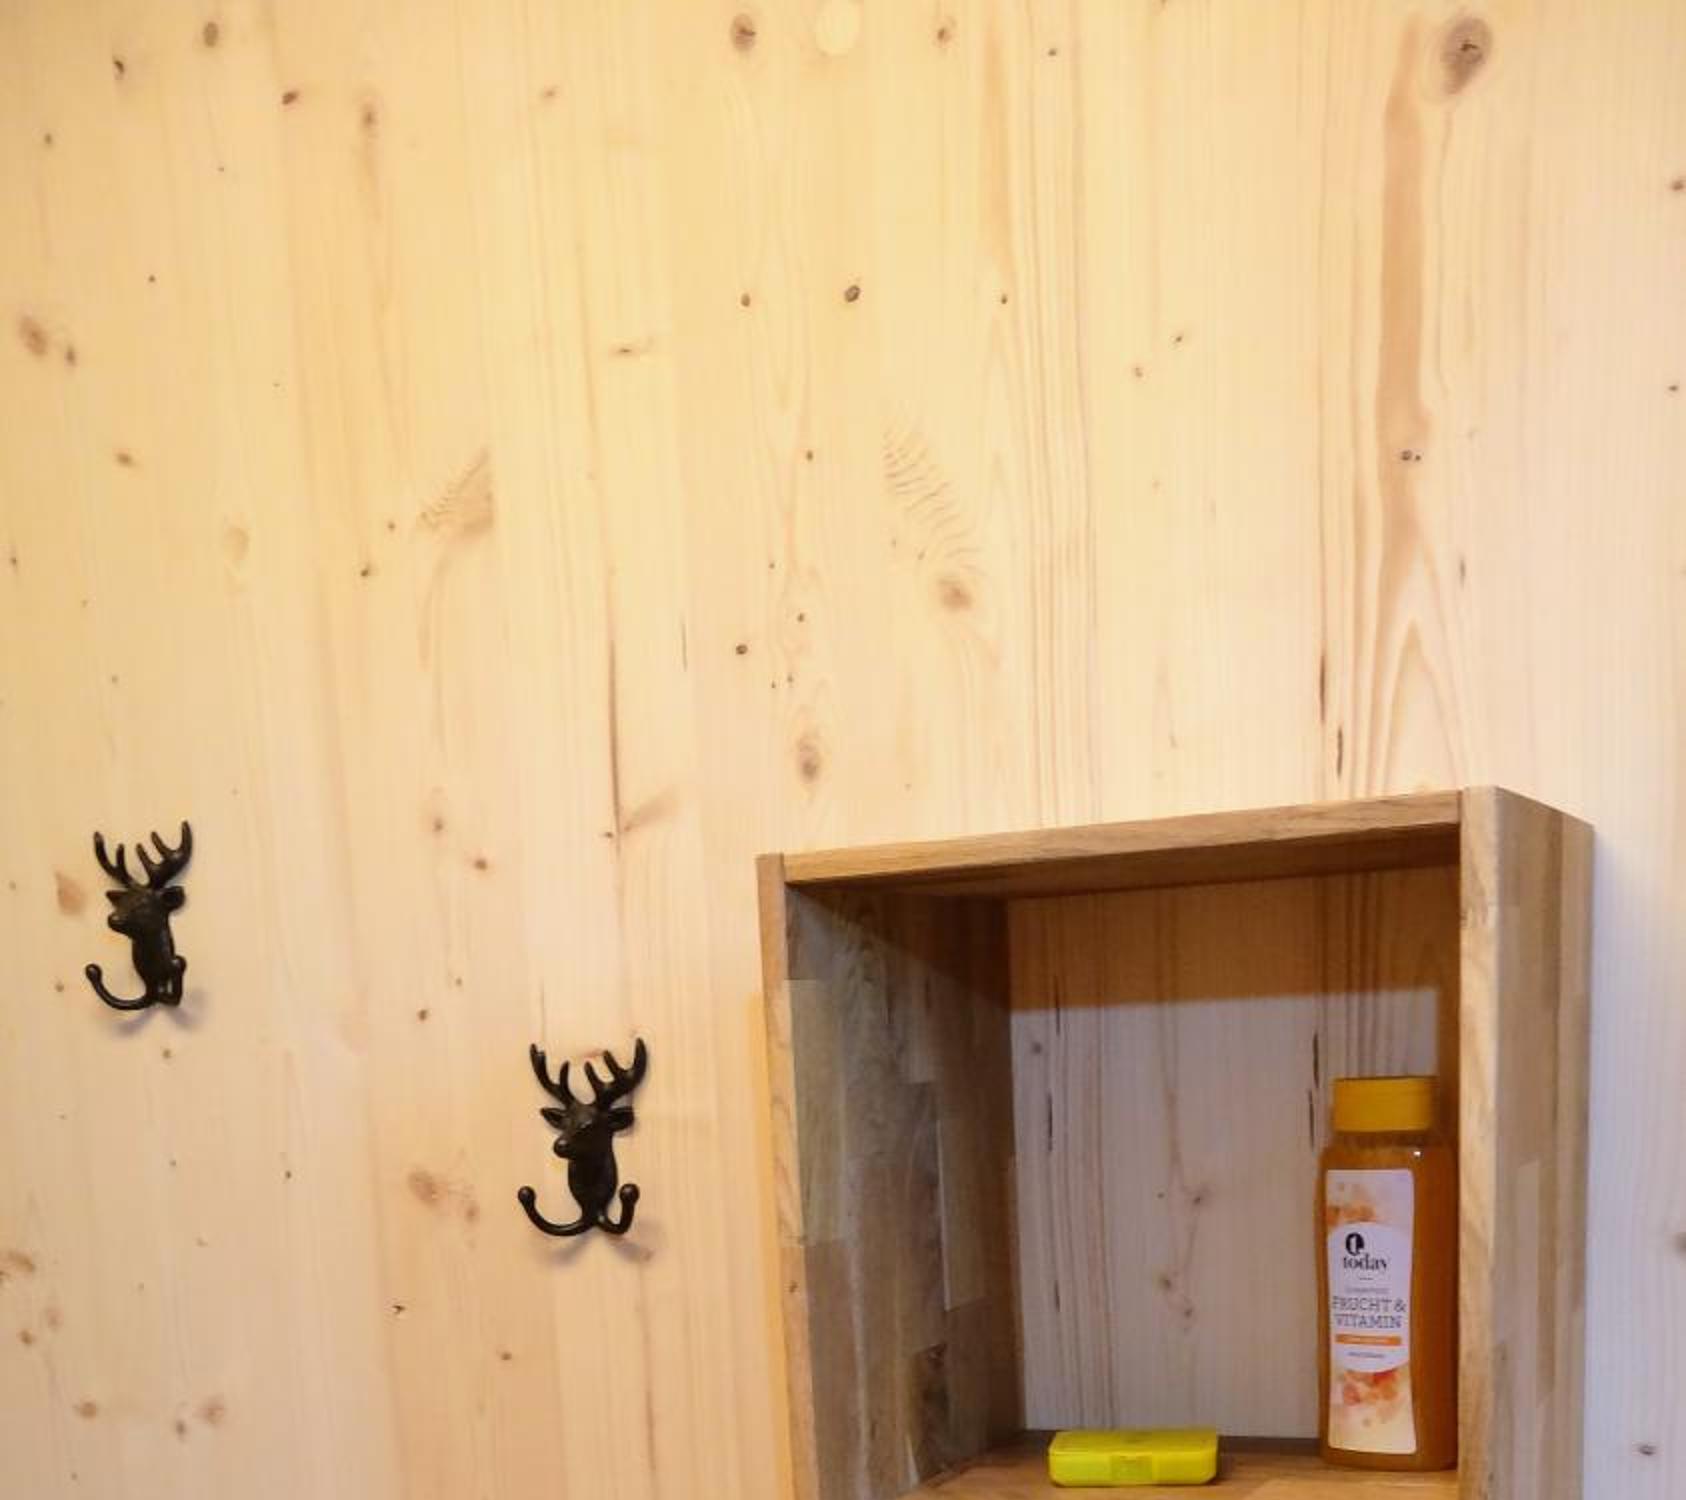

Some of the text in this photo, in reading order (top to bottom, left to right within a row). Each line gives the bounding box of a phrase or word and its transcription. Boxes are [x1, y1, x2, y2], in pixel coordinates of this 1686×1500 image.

[1343, 1253, 1388, 1272] today
[1332, 1296, 1406, 1312] FRUCHT &
[1334, 1314, 1403, 1328] VITAMIN
